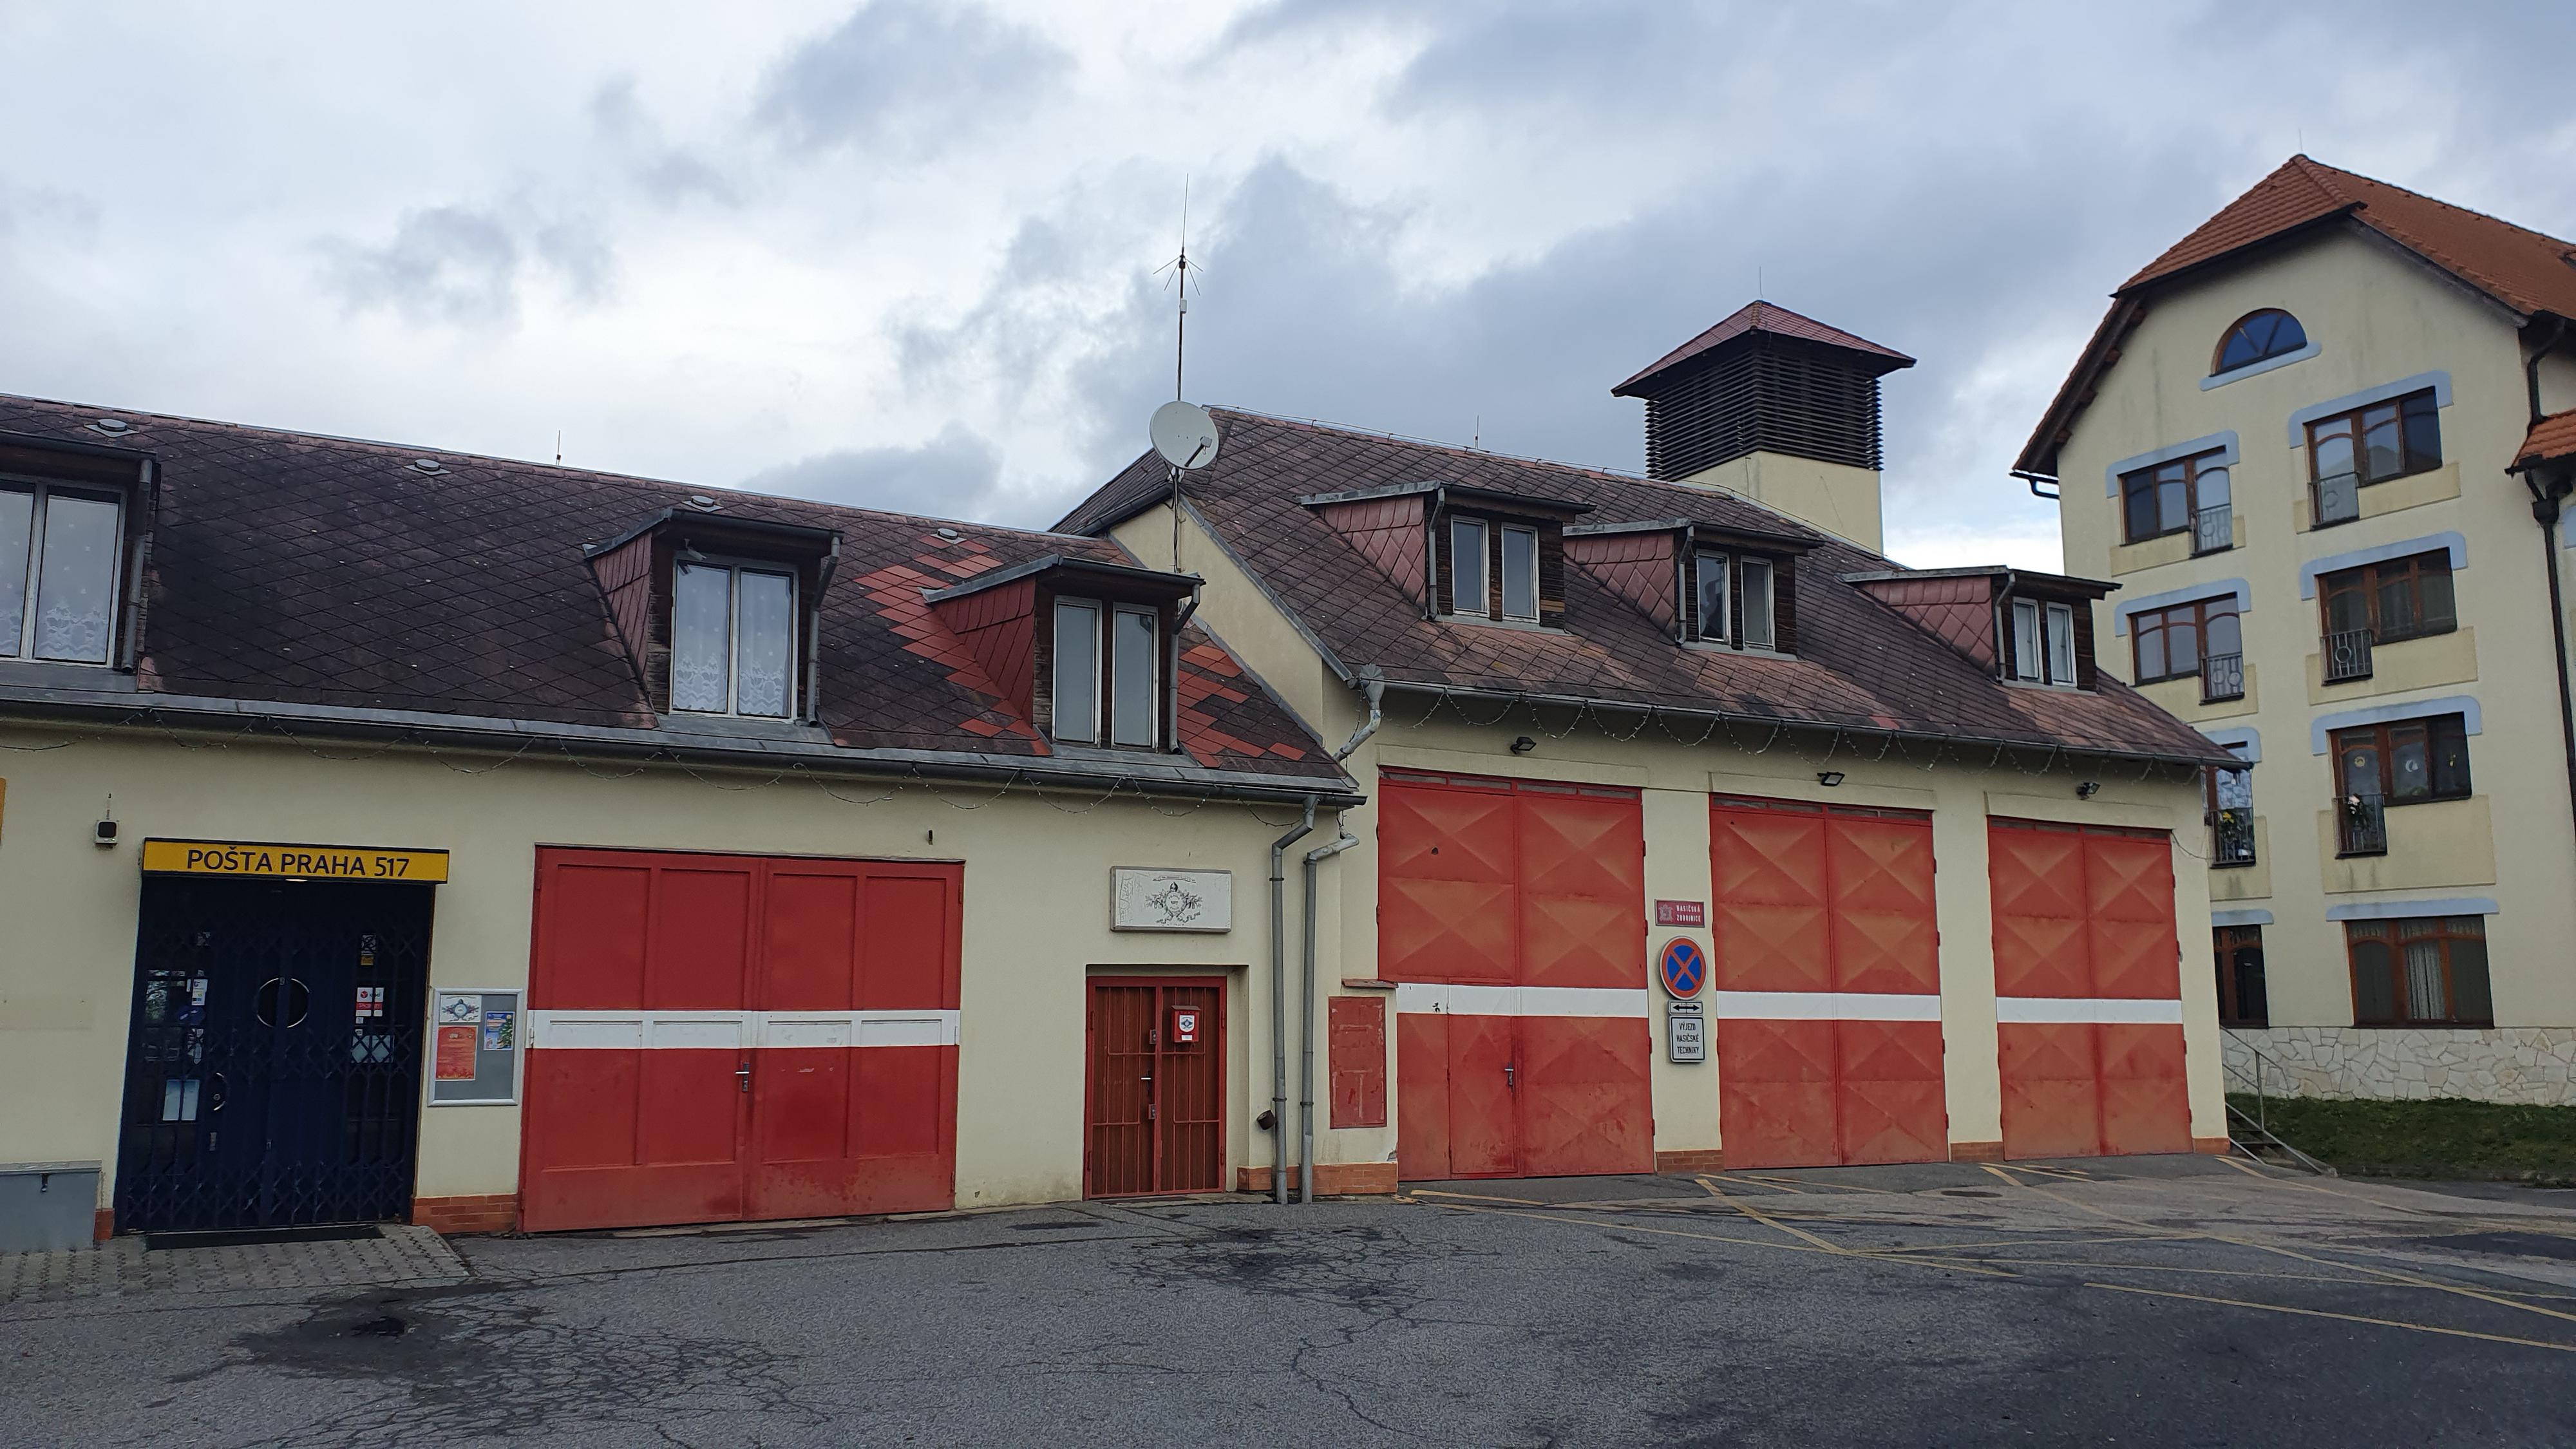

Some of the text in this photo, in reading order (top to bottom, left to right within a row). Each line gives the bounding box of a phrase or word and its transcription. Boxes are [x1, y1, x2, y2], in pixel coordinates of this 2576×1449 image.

[187, 846, 410, 877] POŠTA PRAHA 517
[1679, 1021, 1696, 1031] VÝJEZD
[1676, 1033, 1699, 1043] HASIČSKÉ
[1677, 1046, 1700, 1054] TECHNIKY
